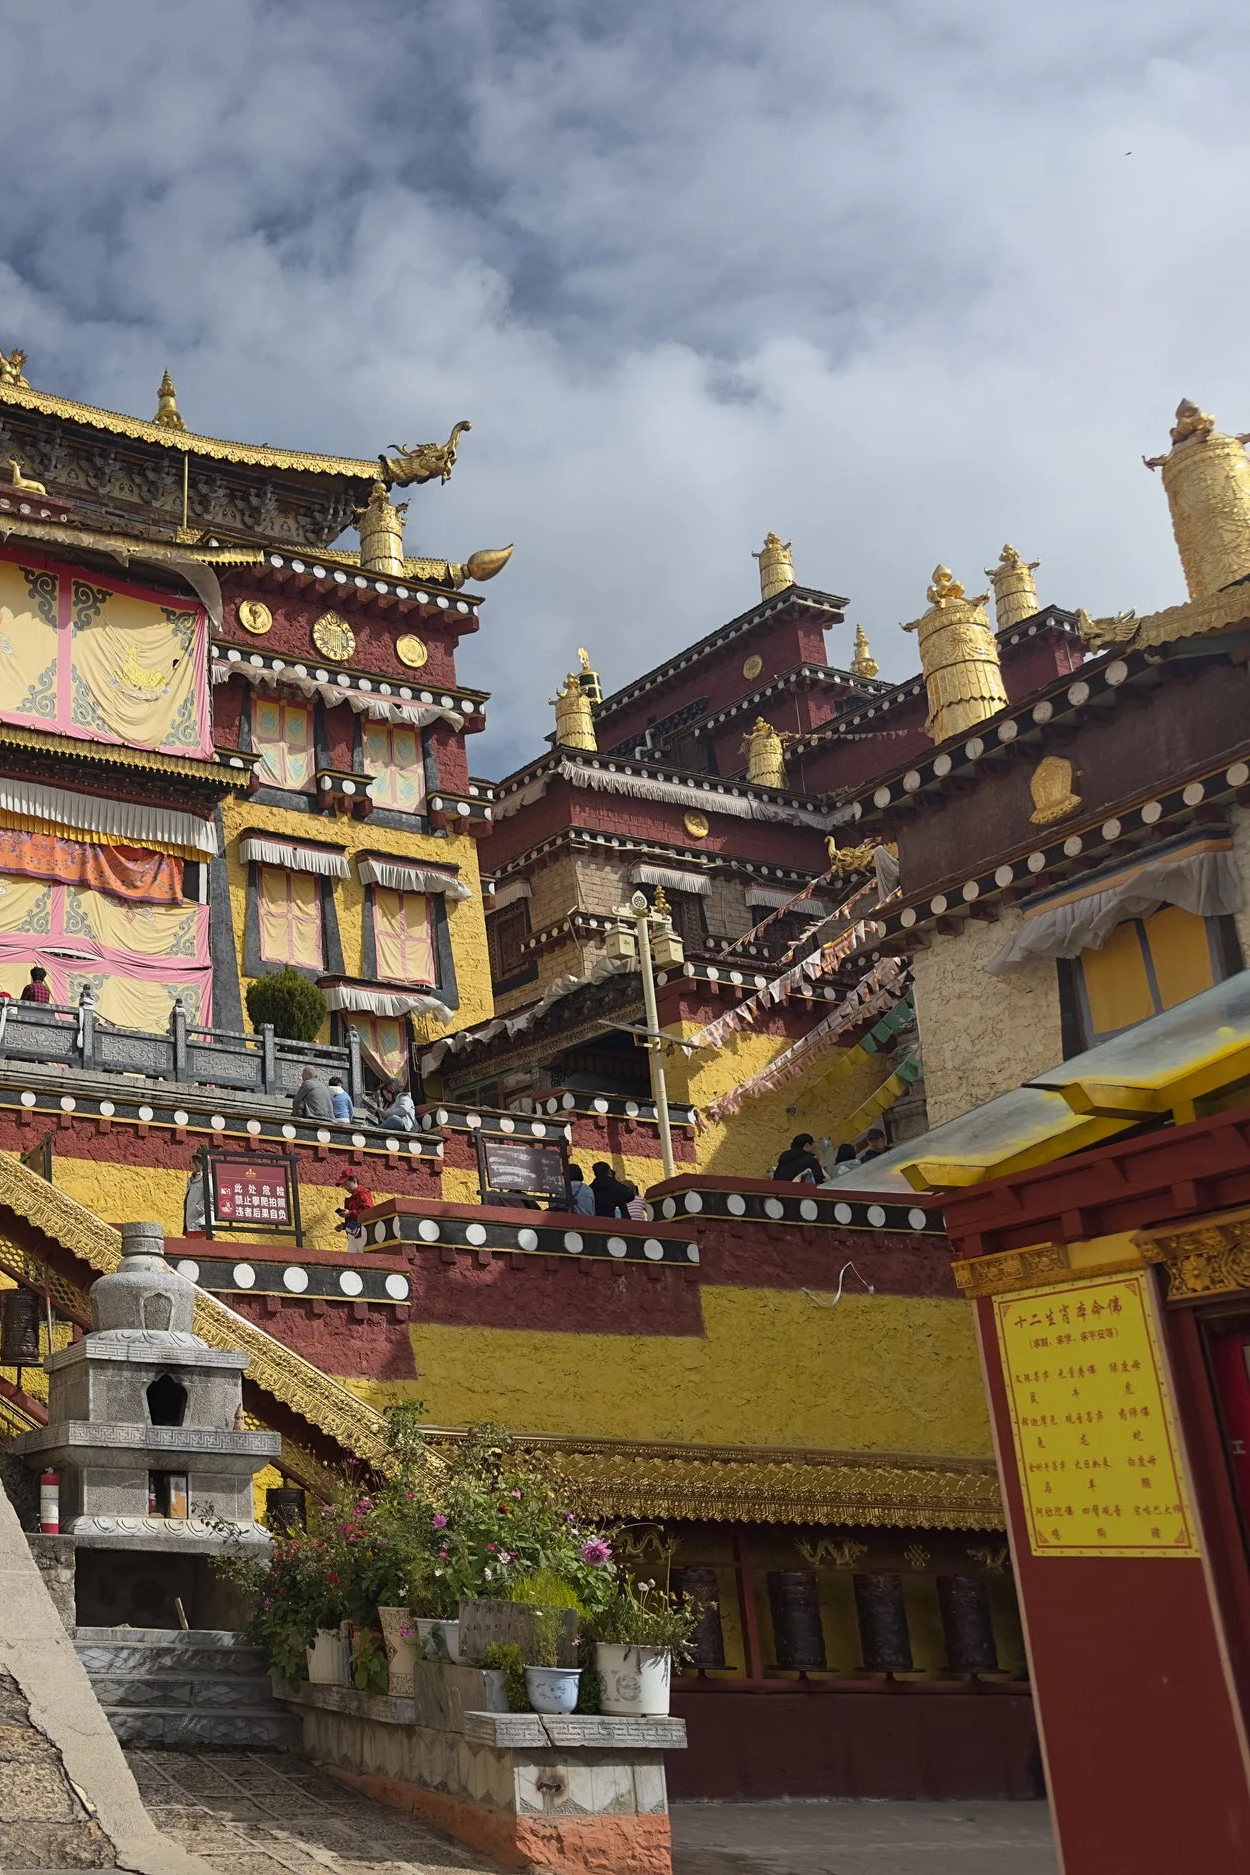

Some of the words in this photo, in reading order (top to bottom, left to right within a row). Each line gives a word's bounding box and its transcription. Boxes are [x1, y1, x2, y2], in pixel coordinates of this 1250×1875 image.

[234, 1183, 285, 1197] 此处危险
[234, 1194, 286, 1208] 禁止攀爬拍照
[235, 1206, 287, 1220] 违者后果自负
[1071, 1386, 1080, 1400] 牛
[1132, 1430, 1144, 1442] 蛇
[1088, 1477, 1097, 1491] 羊
